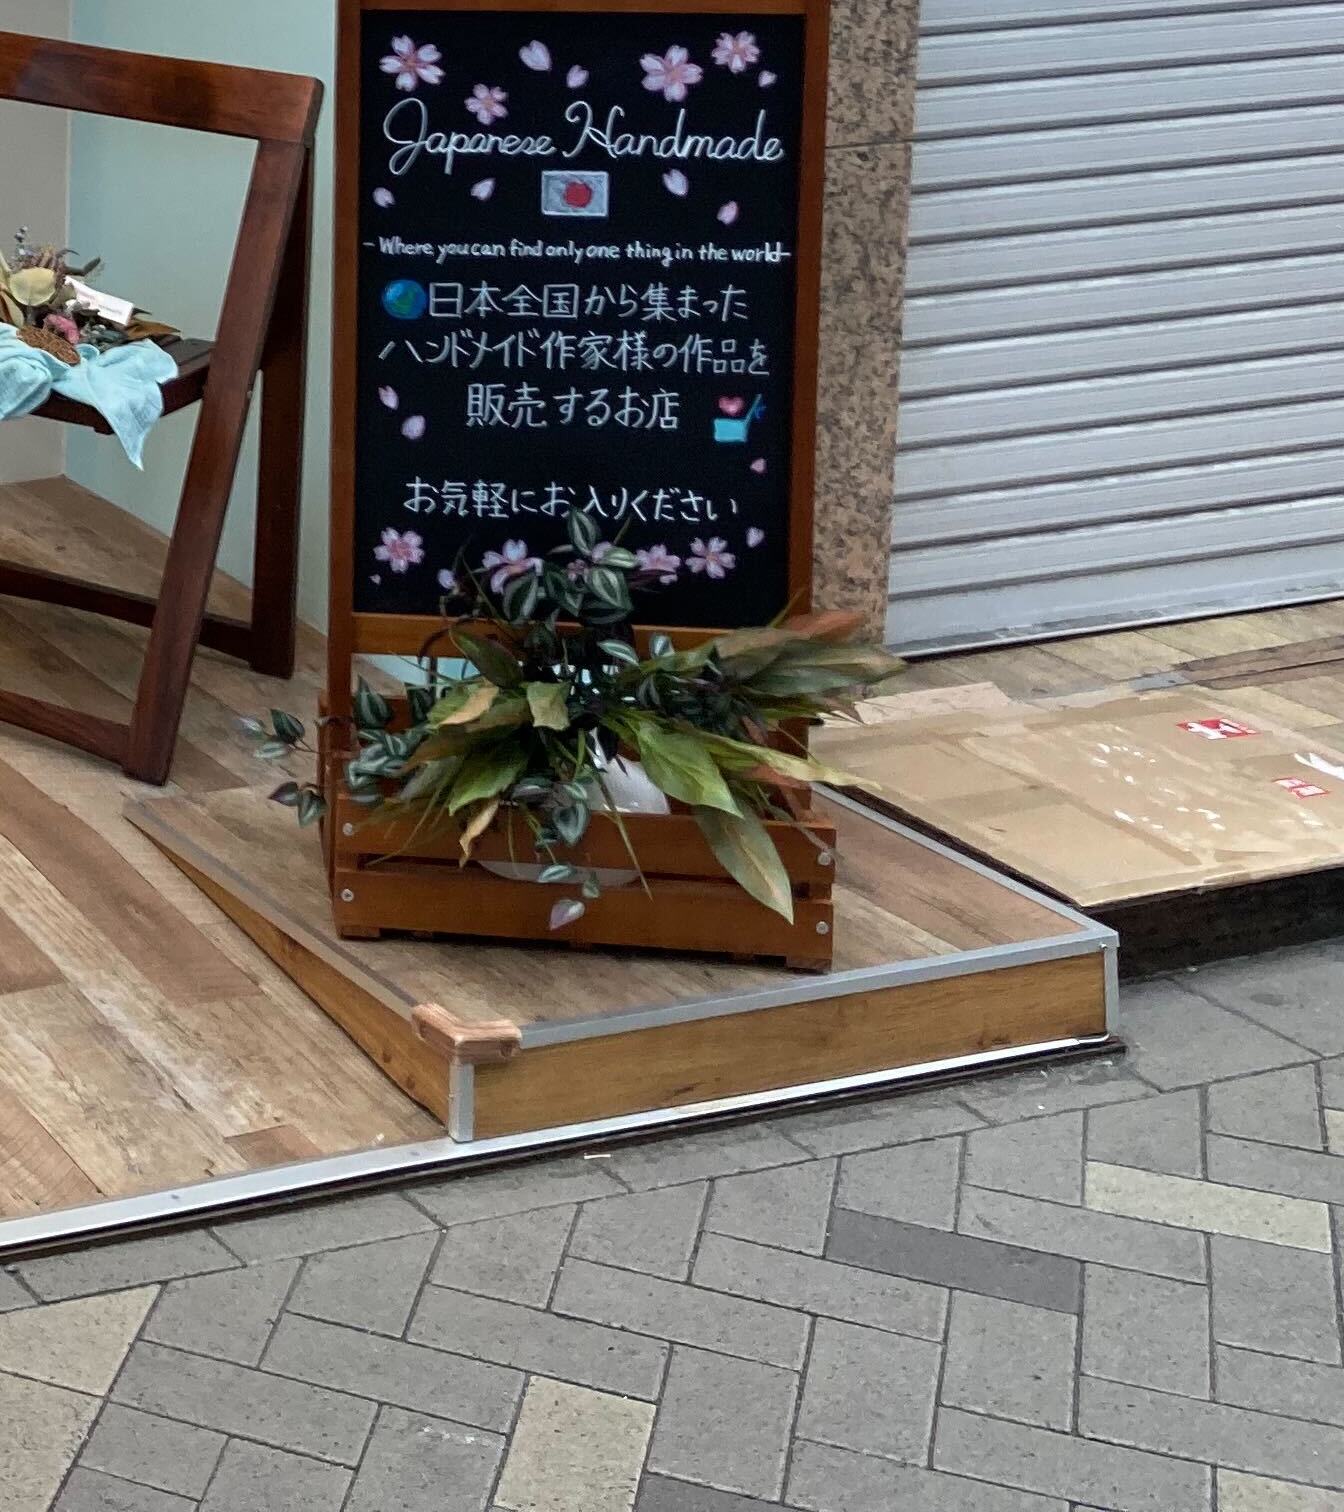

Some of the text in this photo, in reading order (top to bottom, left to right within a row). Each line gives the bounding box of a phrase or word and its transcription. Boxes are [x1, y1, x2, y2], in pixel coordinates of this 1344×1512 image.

[383, 97, 784, 175] Japanese Handmade
[436, 244, 470, 265] you
[470, 243, 506, 257] can
[510, 238, 543, 257] find
[545, 240, 584, 265] only
[586, 244, 621, 258] one
[625, 240, 673, 267] thing
[674, 243, 694, 260] in
[698, 242, 728, 261] the
[428, 281, 749, 322] 日本全国から集まった
[378, 327, 770, 376] ハンドメイド作家様の作品を
[465, 382, 680, 430] 販売するお店
[403, 476, 738, 522] お気軽にお入りください
